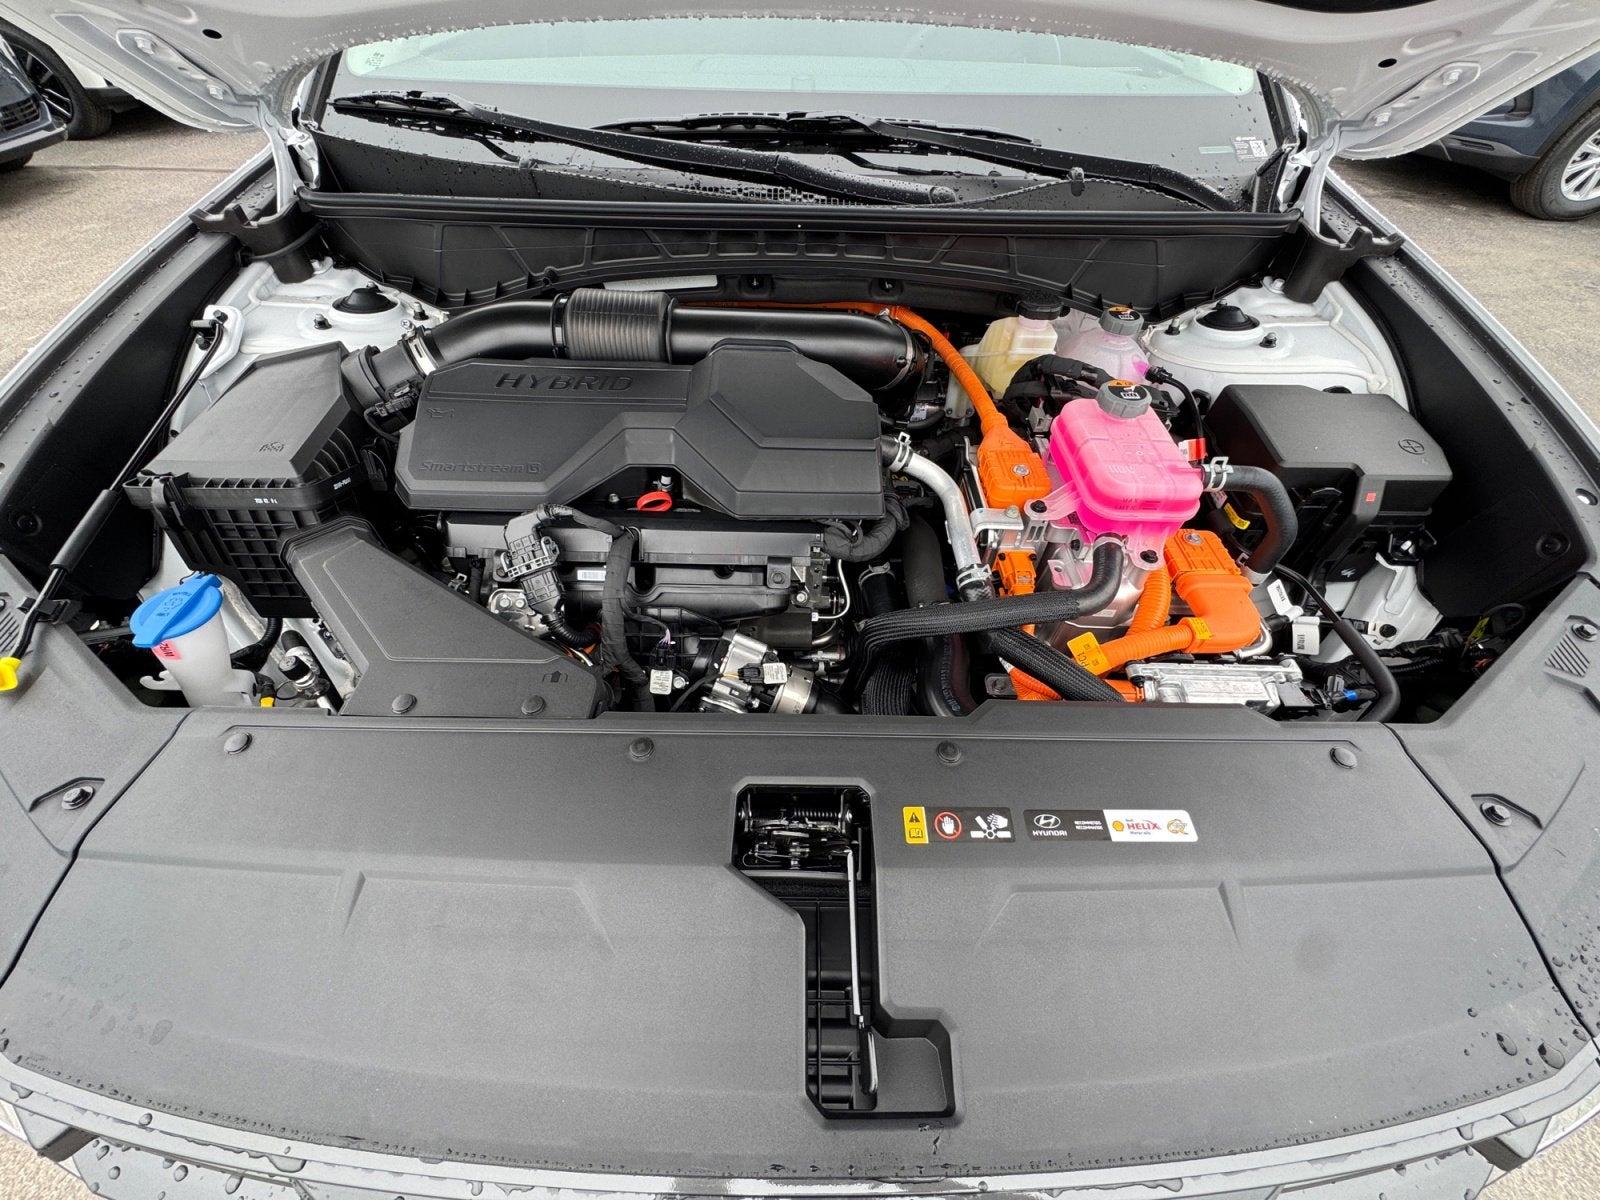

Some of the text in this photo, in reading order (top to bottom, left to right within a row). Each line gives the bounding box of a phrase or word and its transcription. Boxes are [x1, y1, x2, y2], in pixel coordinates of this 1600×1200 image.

[495, 373, 633, 391] HYBRID
[420, 460, 525, 473] Smartstream
[1126, 822, 1161, 831] HELIX
